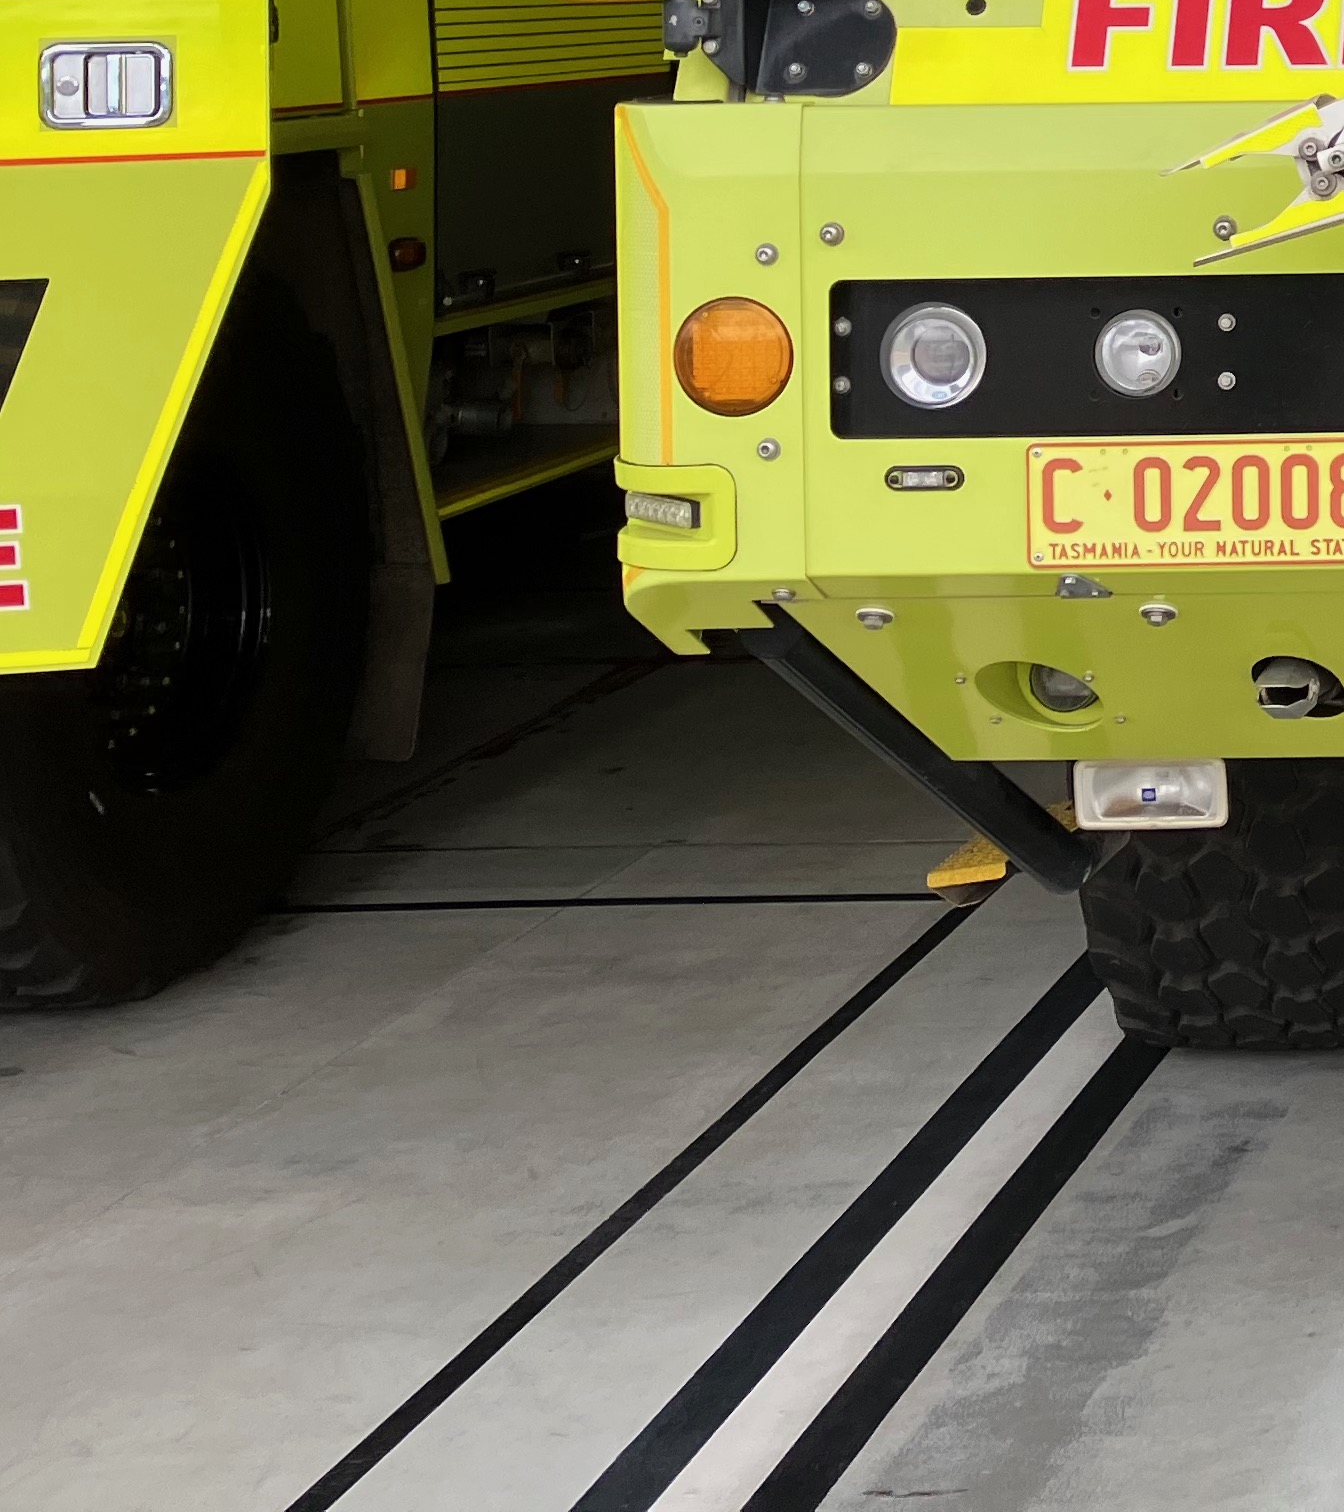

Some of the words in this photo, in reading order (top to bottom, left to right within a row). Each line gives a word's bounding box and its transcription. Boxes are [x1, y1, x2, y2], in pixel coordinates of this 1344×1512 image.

[1041, 457, 1085, 534] C
[1049, 542, 1141, 561] TASMANIA
[1158, 541, 1204, 558] YOUR
[1215, 539, 1300, 557] NATURAL
